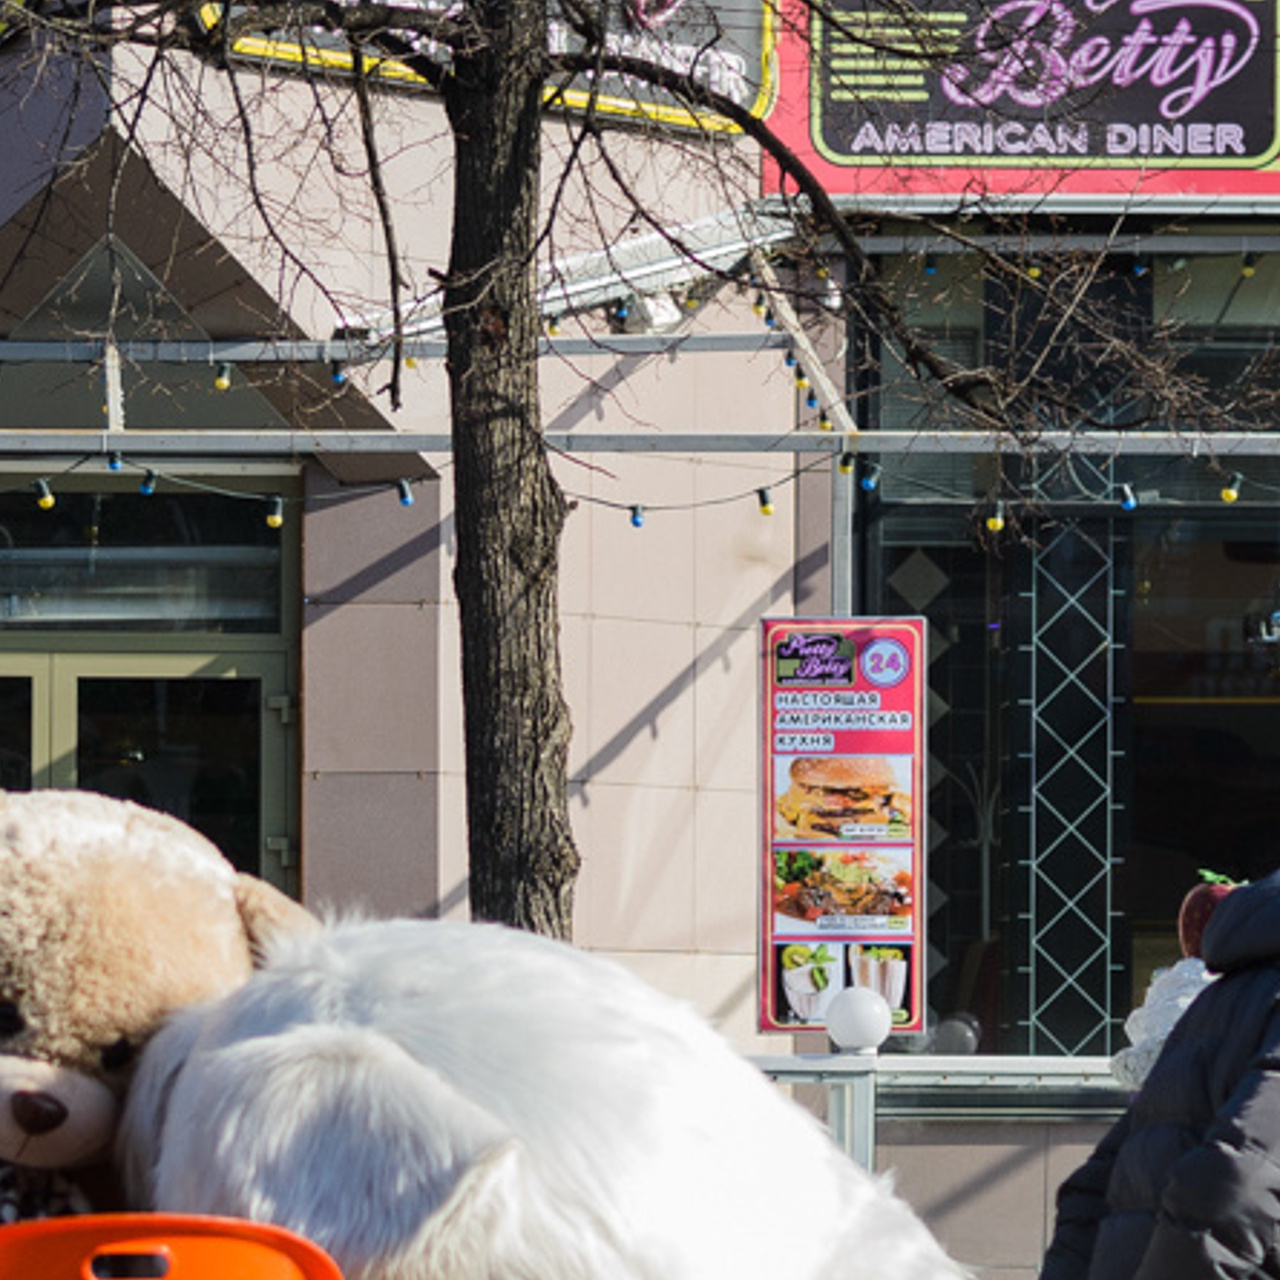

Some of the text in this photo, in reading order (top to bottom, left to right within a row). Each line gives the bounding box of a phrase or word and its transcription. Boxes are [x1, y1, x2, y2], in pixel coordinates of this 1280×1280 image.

[851, 121, 1246, 154] AMERICAN DINER
[869, 651, 901, 673] 24
[778, 713, 908, 726] АМЕРИКАНСКАЯ
[778, 734, 831, 746] КУХНЯ
